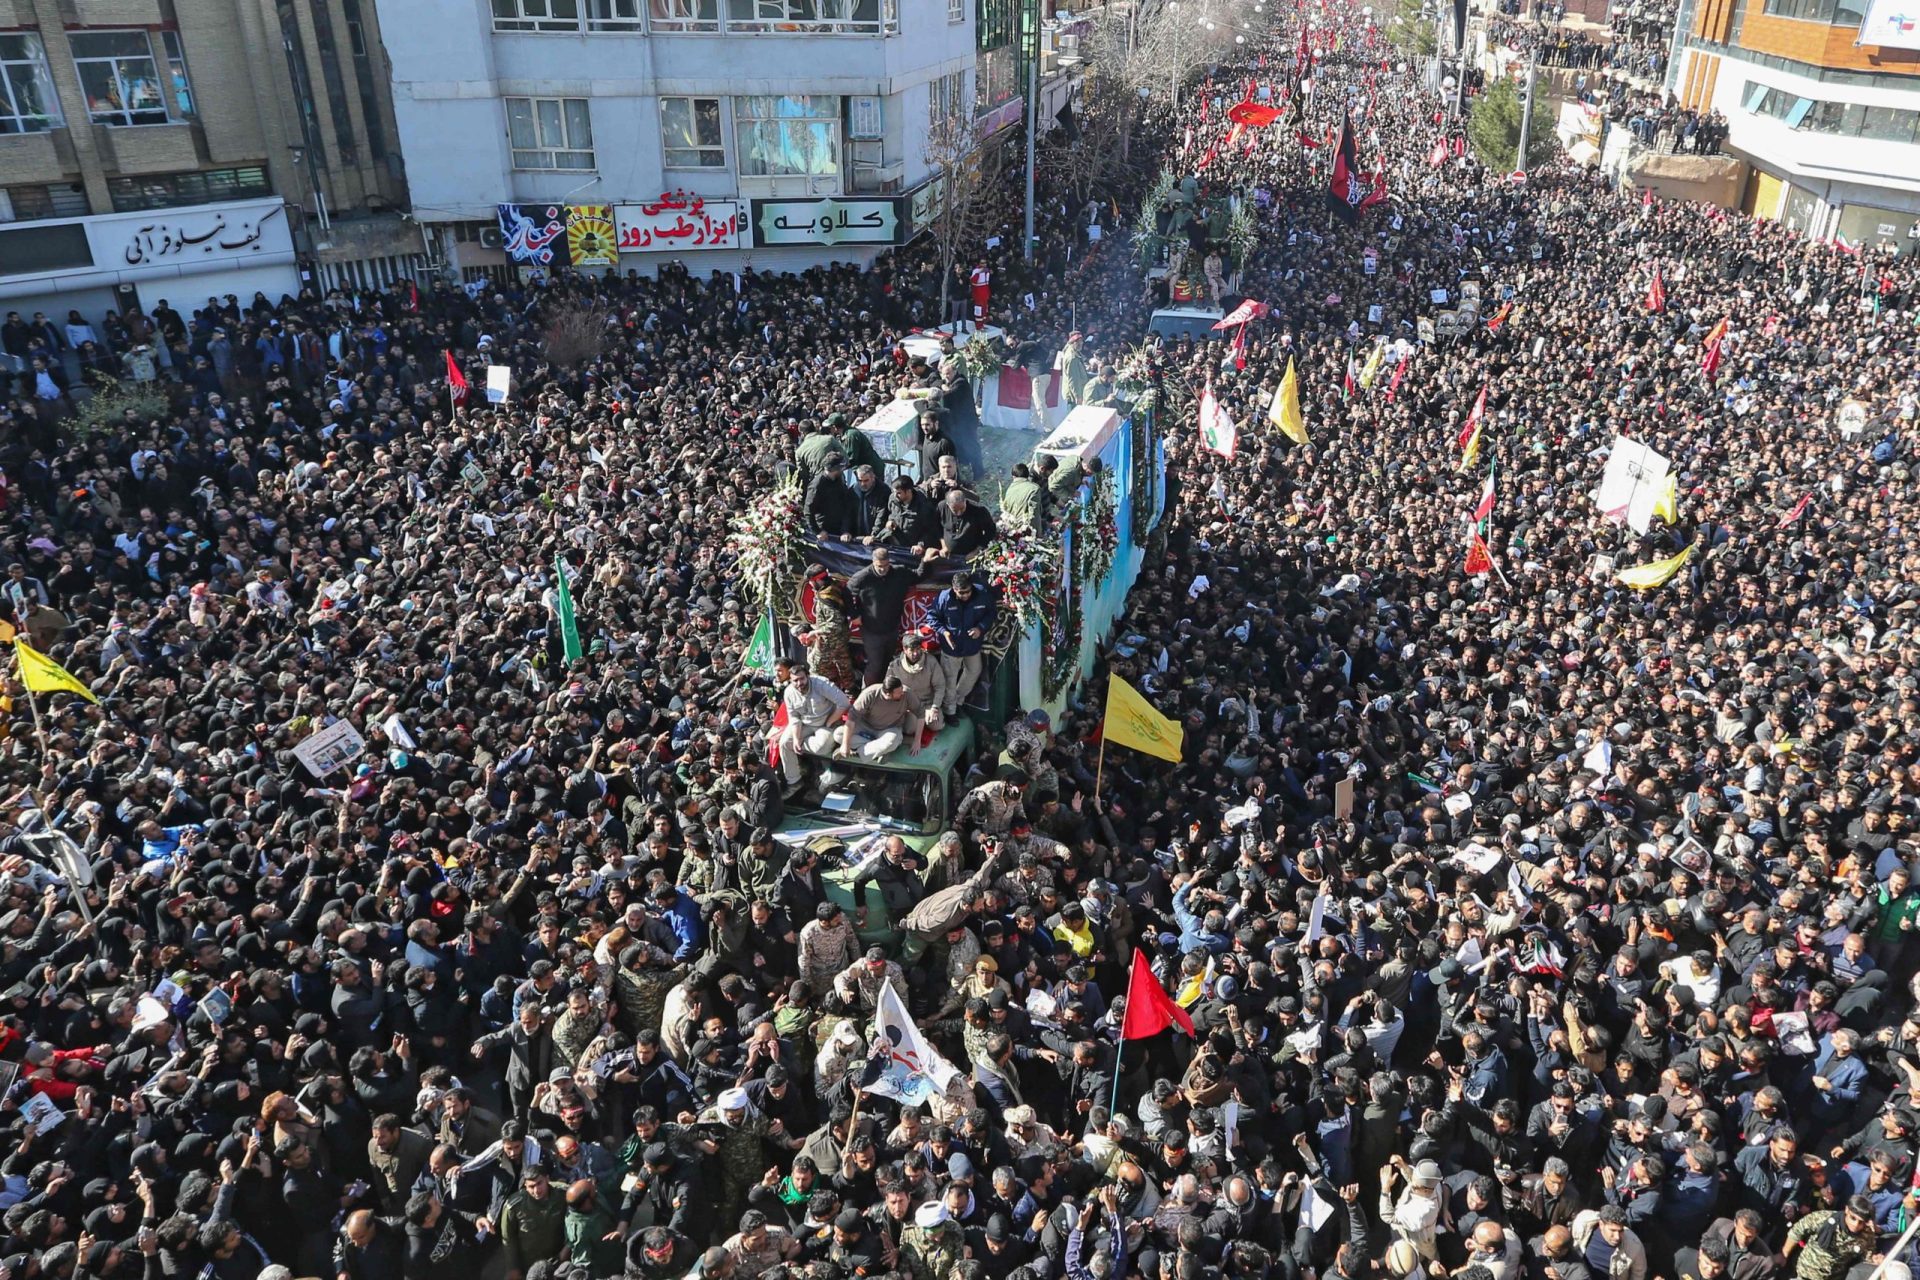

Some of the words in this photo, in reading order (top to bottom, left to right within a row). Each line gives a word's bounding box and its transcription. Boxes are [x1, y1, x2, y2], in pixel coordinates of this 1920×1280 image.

[642, 187, 704, 219] پزشکی
[159, 213, 226, 256] نیلوفر
[219, 206, 281, 250] کیف
[619, 222, 651, 247] روز
[653, 215, 694, 245] طب
[693, 214, 736, 244] ابزار
[773, 208, 884, 235] کلاویه
[125, 225, 154, 264] آبی
